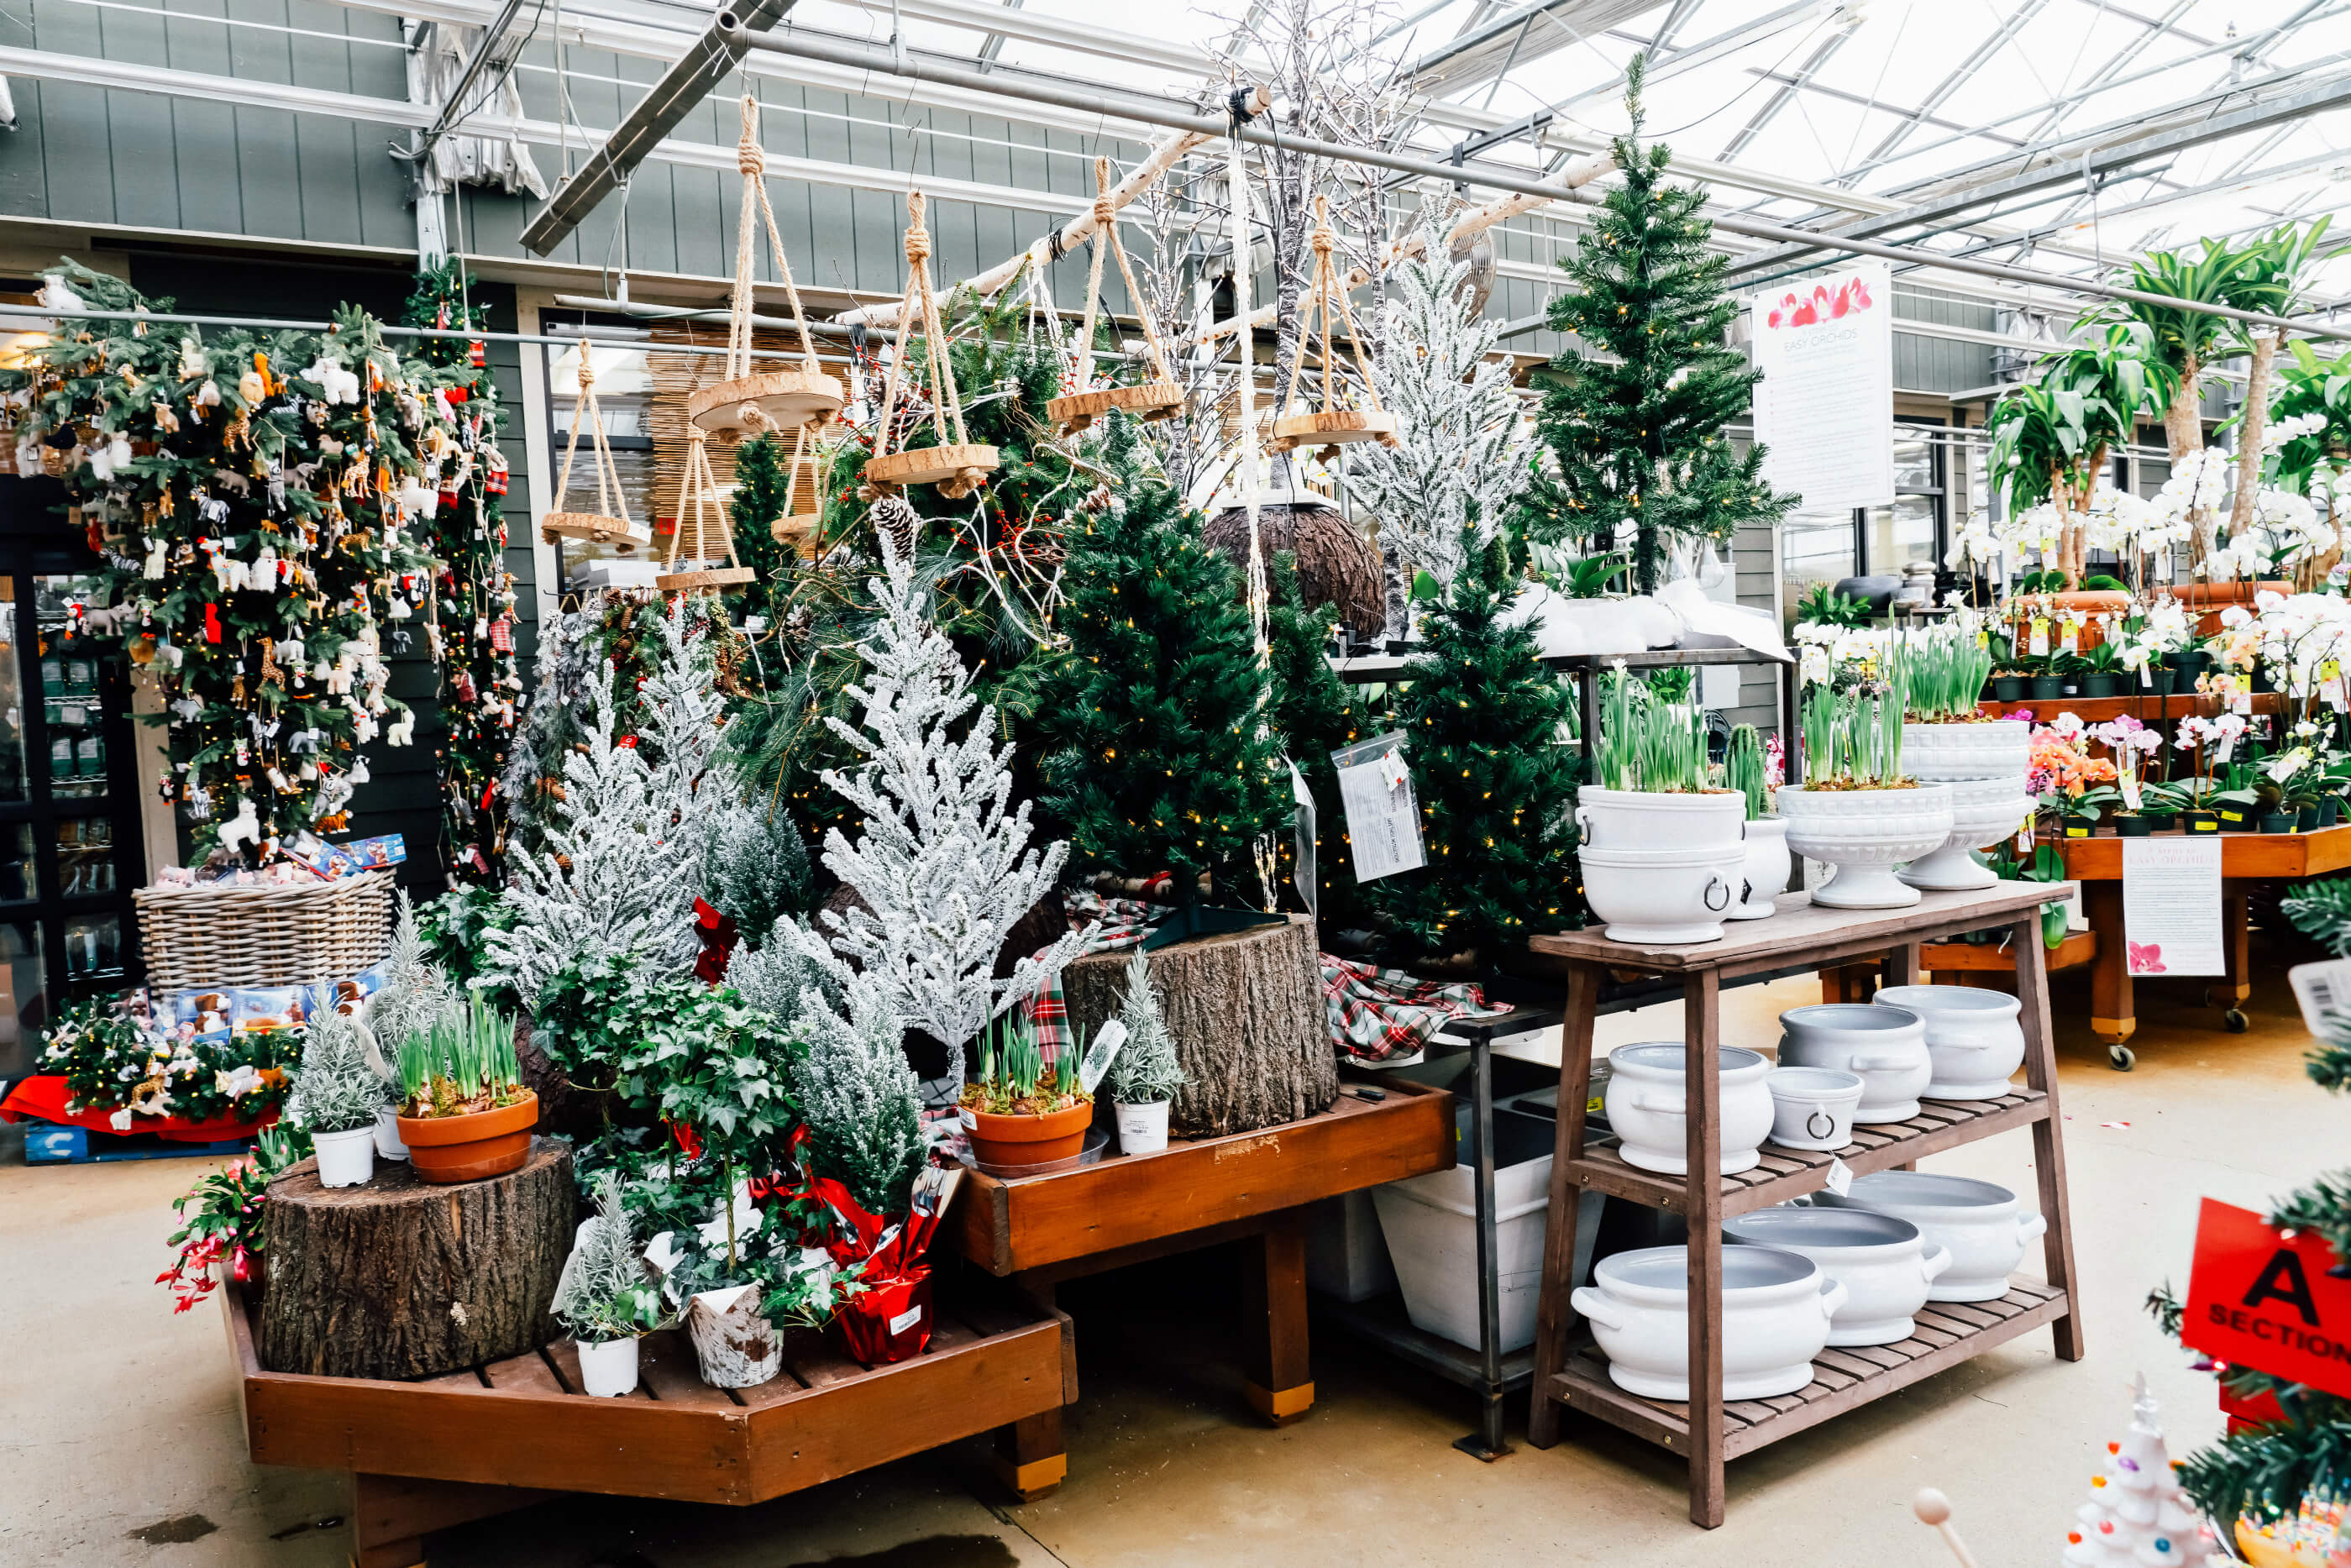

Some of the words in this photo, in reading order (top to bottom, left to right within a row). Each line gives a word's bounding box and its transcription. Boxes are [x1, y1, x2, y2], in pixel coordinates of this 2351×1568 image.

[1783, 338, 1808, 352] EASY
[1810, 328, 1859, 347] ORCHIDS
[2242, 1248, 2321, 1327] A
[2208, 1303, 2351, 1366] SECTION
